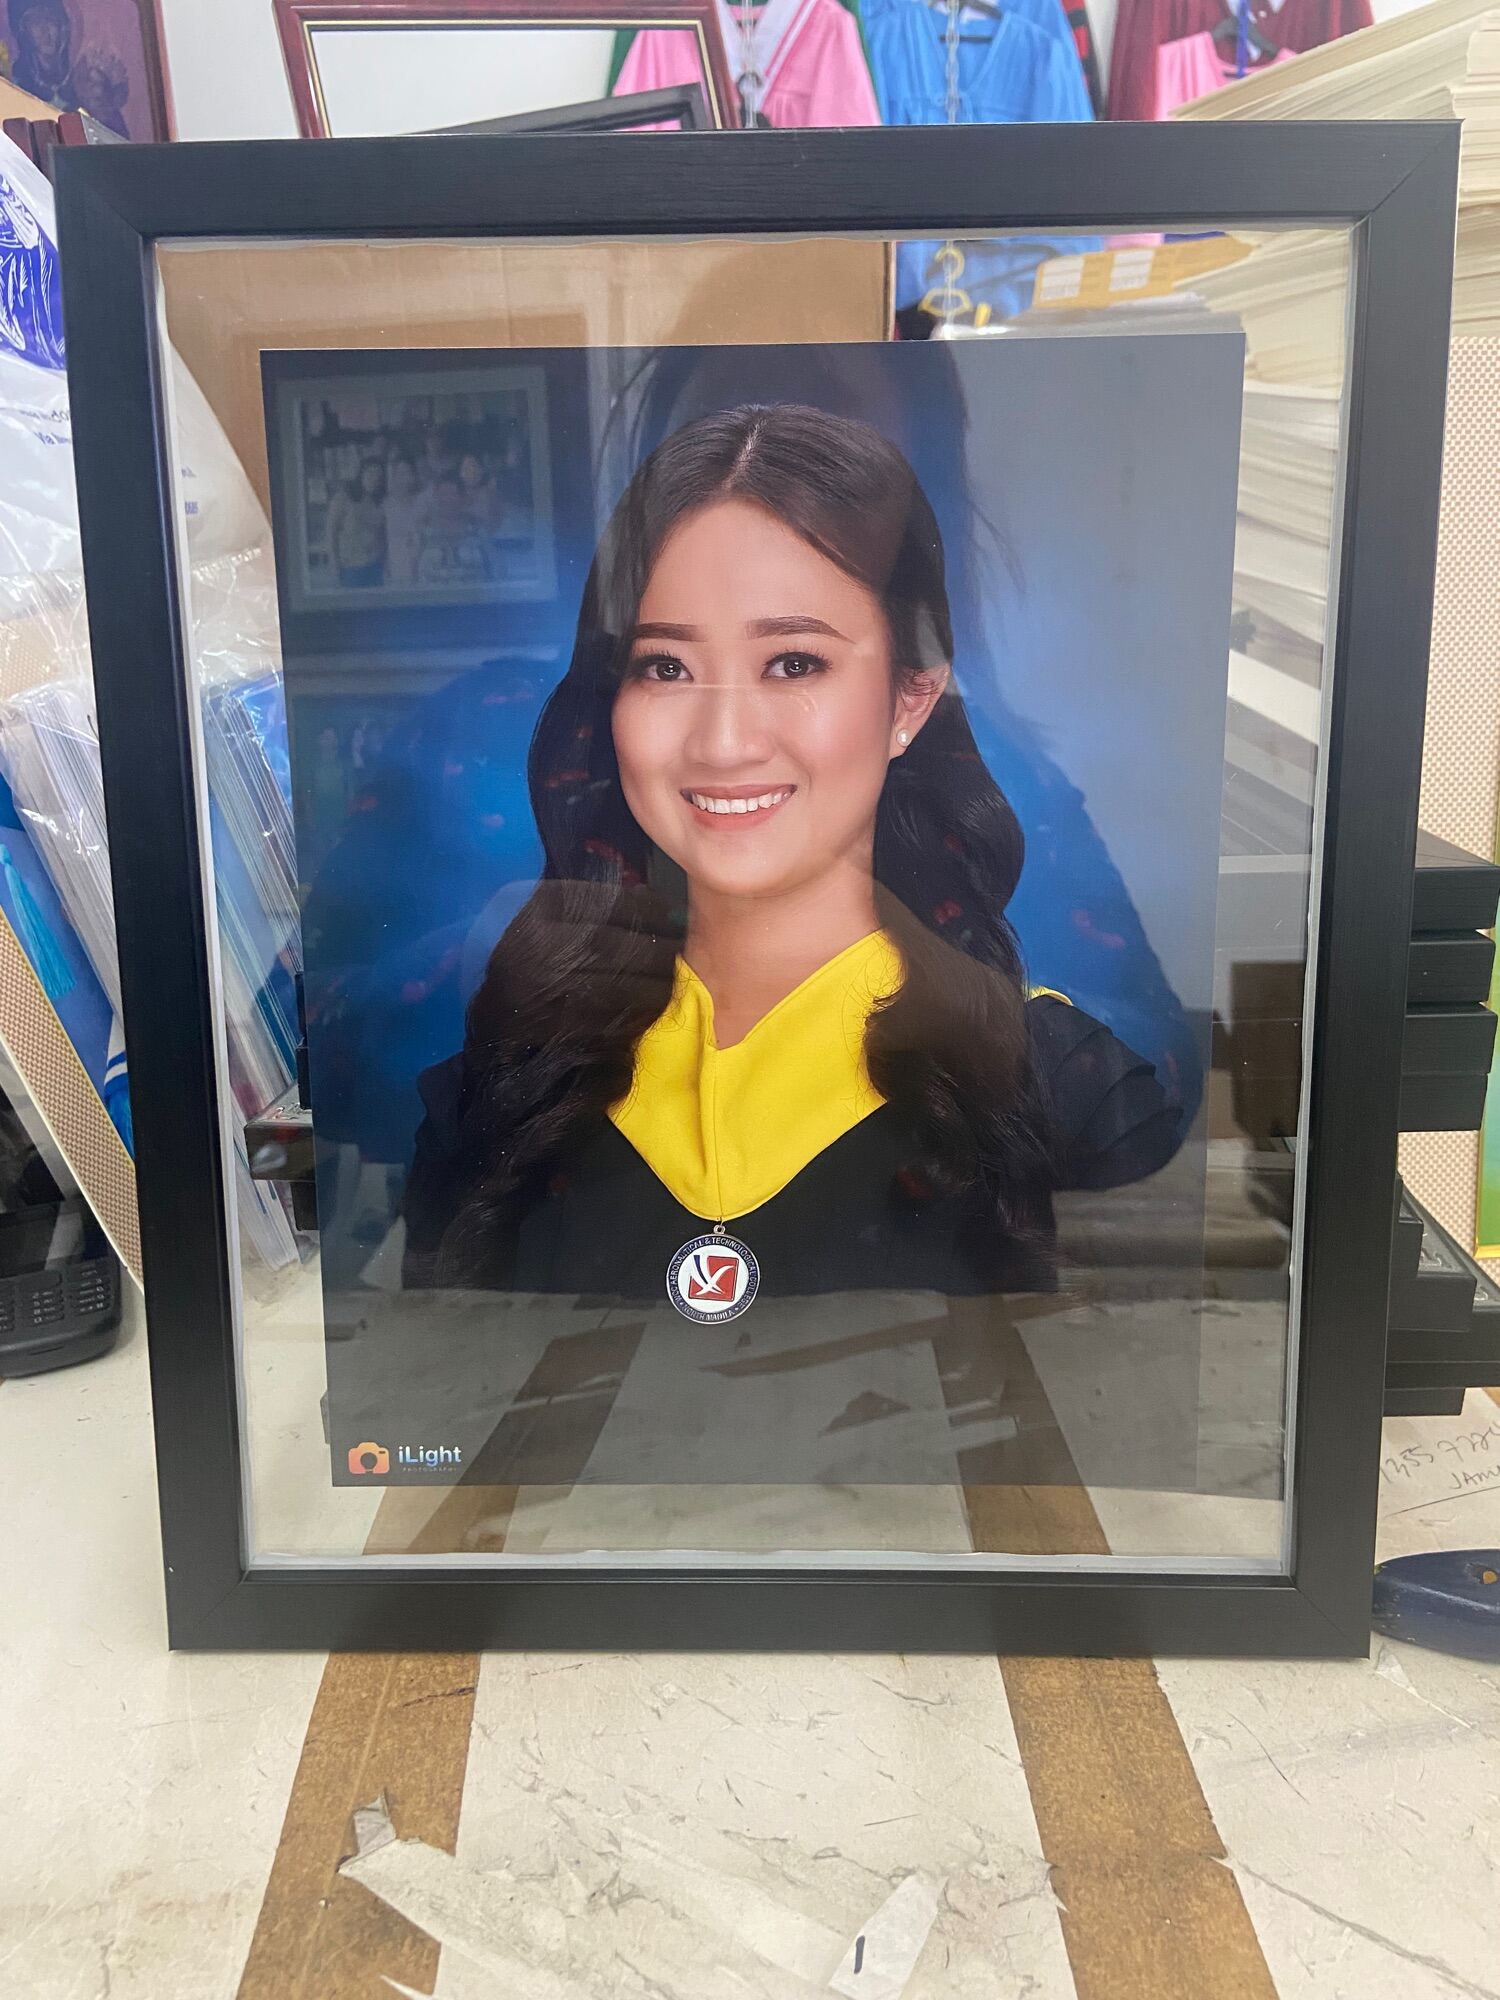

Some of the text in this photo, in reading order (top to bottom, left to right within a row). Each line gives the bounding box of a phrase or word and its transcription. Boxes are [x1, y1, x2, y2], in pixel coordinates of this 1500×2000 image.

[670, 1239, 704, 1285] AERONAUTICAL
[711, 1236, 757, 1276] TECHNOLOGICAL
[738, 1276, 757, 1307] COLLEGE
[398, 1445, 462, 1467] iLight
